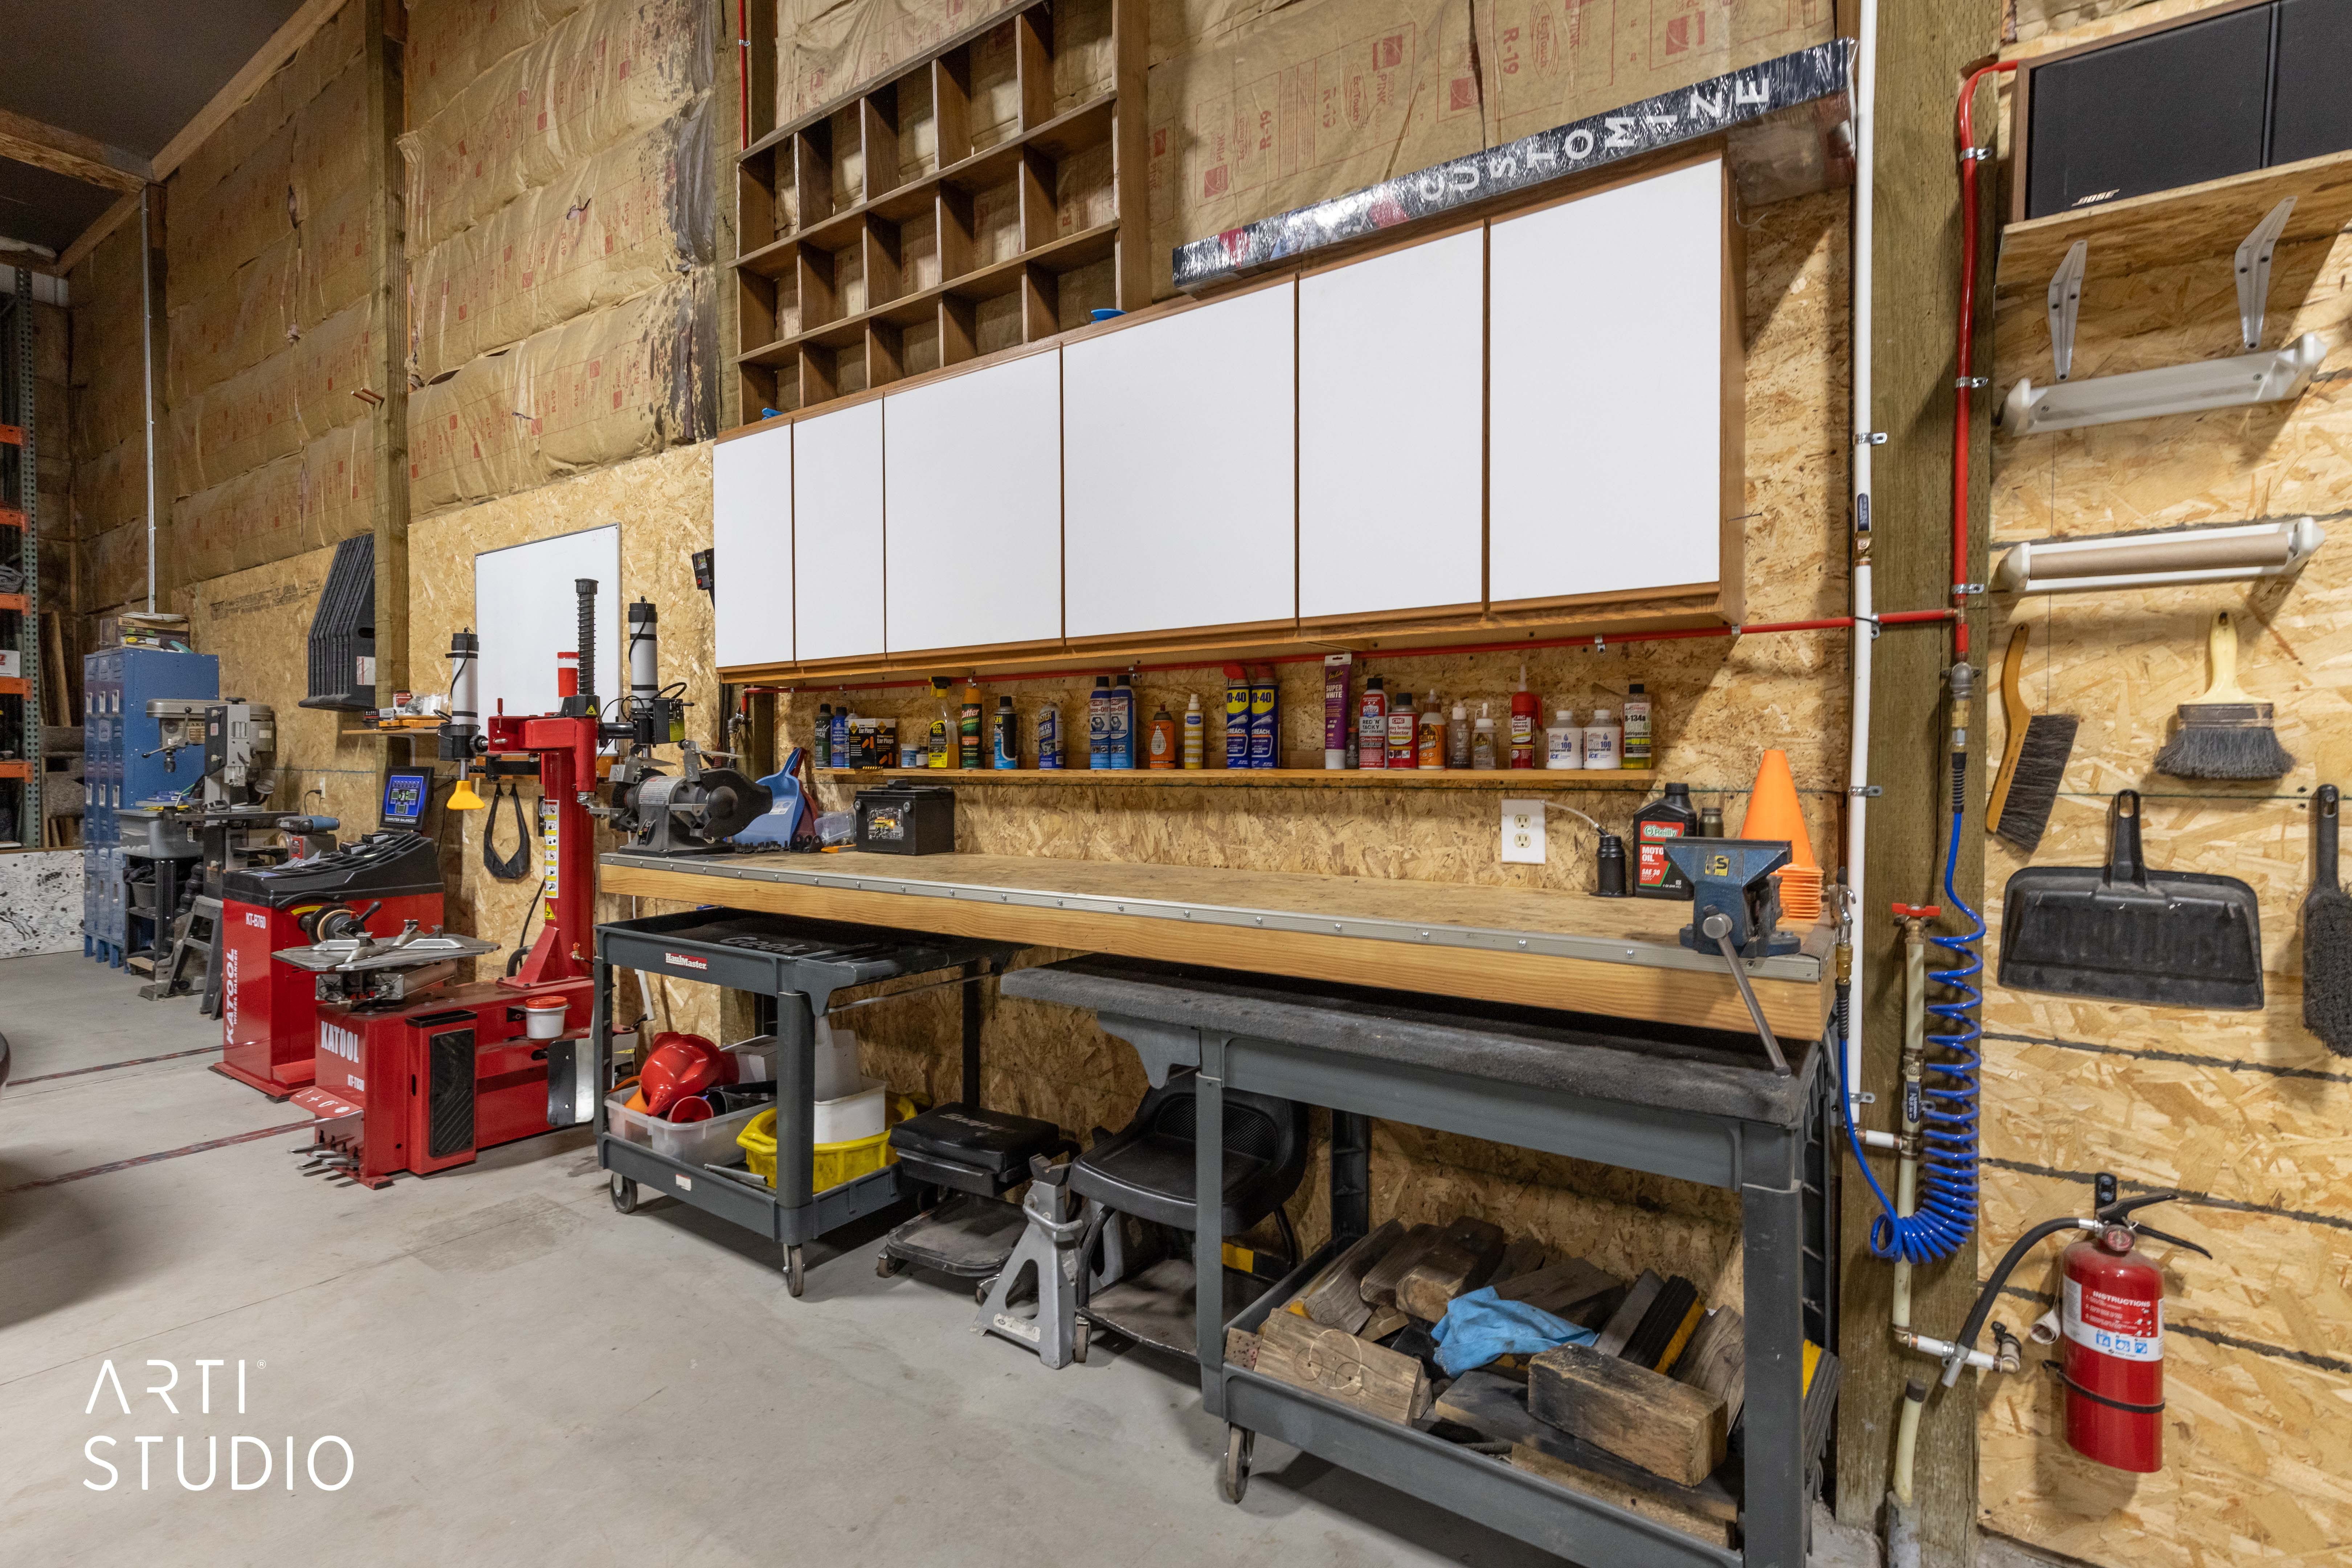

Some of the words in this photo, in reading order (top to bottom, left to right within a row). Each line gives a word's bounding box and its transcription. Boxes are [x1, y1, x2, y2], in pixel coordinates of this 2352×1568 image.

[1503, 27, 1519, 74] R-19
[1377, 74, 1387, 105] PINK
[1259, 110, 1271, 151] R-19
[1216, 133, 1225, 163] PINK
[1039, 722, 1052, 731] HITE
[1643, 824, 1679, 837] O'Reilly
[1642, 846, 1664, 855] MOTO
[245, 912, 266, 929] KT-B760
[720, 936, 809, 953] Geek
[665, 952, 707, 970] HaulMaster
[321, 1020, 359, 1063] KATOOL
[2092, 1290, 2151, 1307] INSTRUCTIONS
